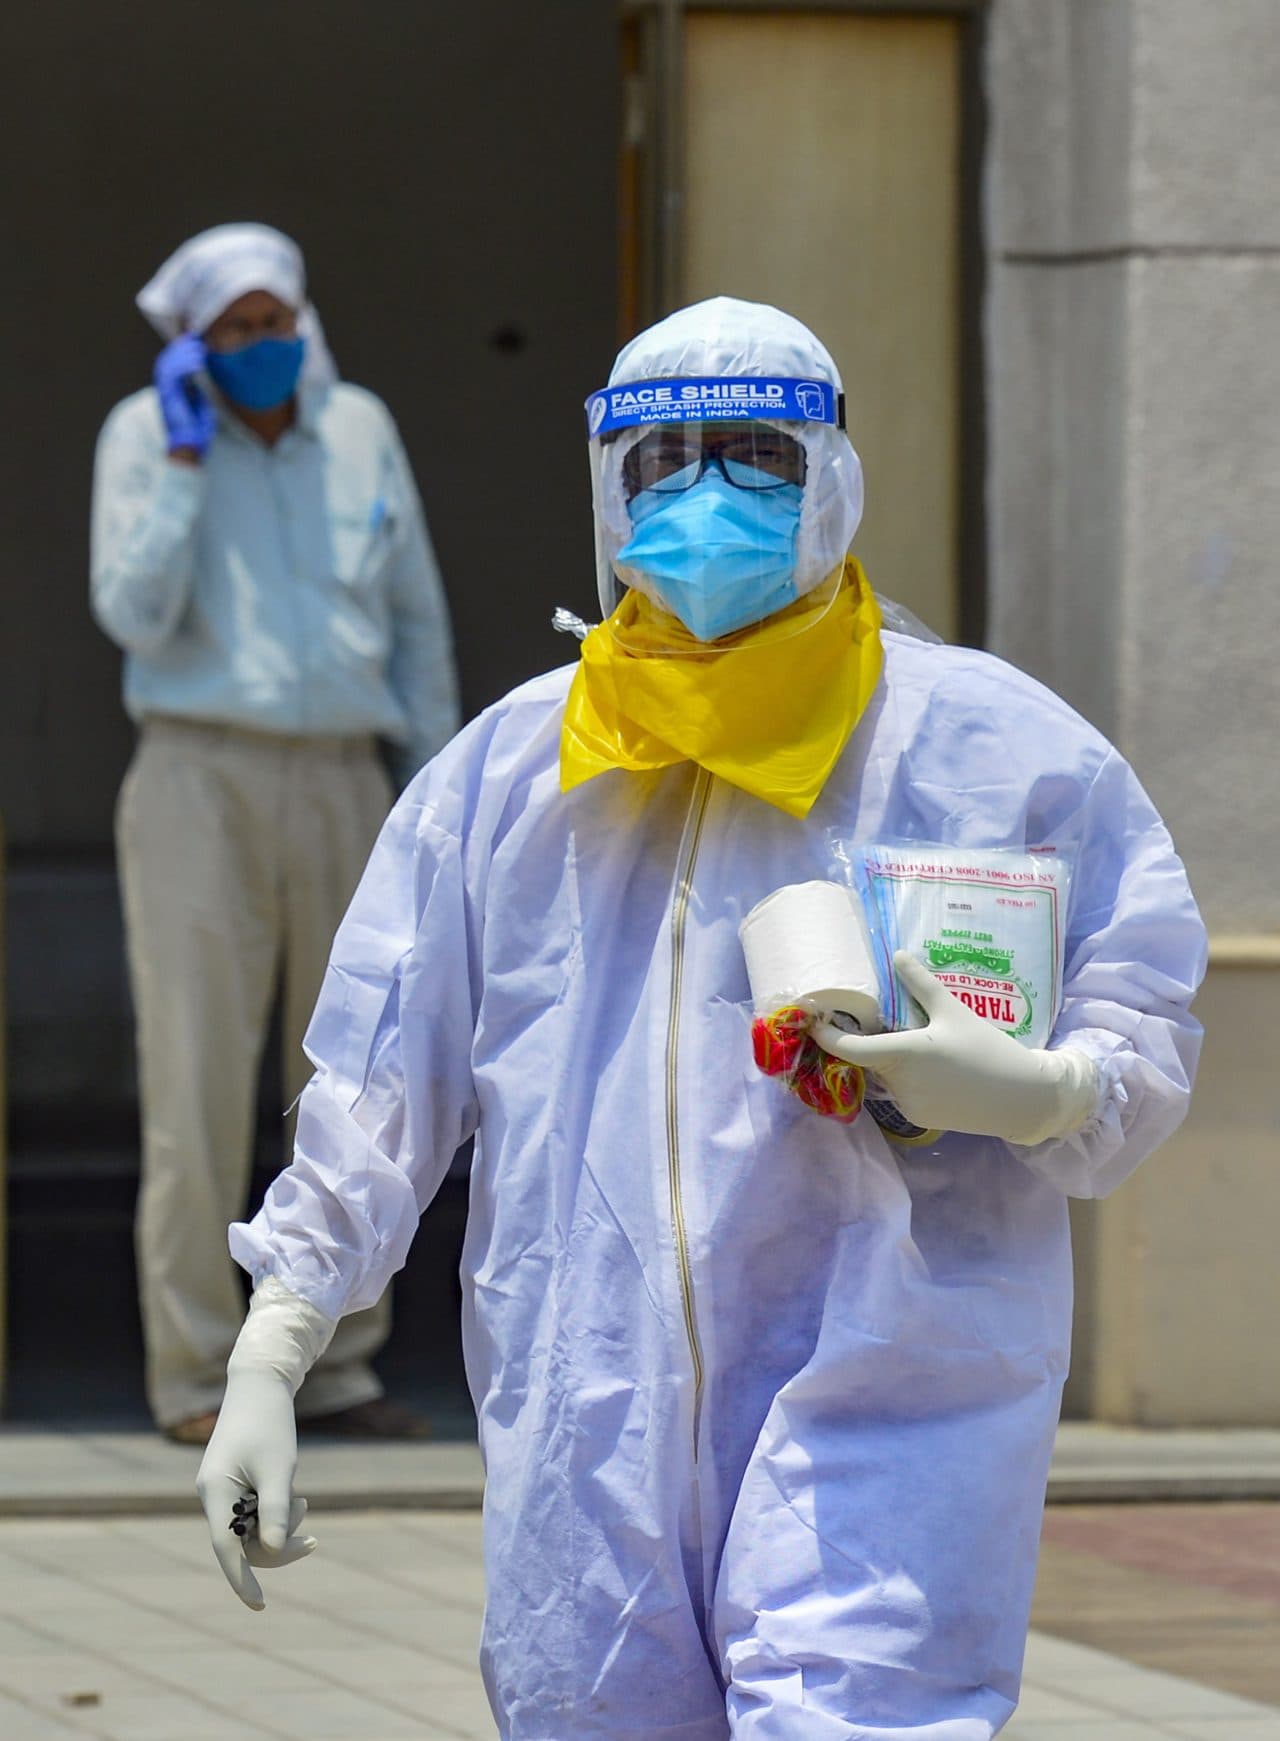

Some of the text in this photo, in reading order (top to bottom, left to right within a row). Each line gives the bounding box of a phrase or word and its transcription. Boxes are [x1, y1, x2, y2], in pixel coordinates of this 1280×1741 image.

[611, 384, 784, 408] FACE SHIELD
[612, 401, 786, 418] DIRECT SPLASH PROTECTION
[640, 409, 749, 421] MADE IN INDIA
[884, 861, 952, 874] CERTIFIED
[1012, 871, 1033, 880] ISO
[922, 939, 941, 948] FAST
[982, 946, 1015, 958] STRONG
[973, 977, 1013, 991] RE-LOCK
